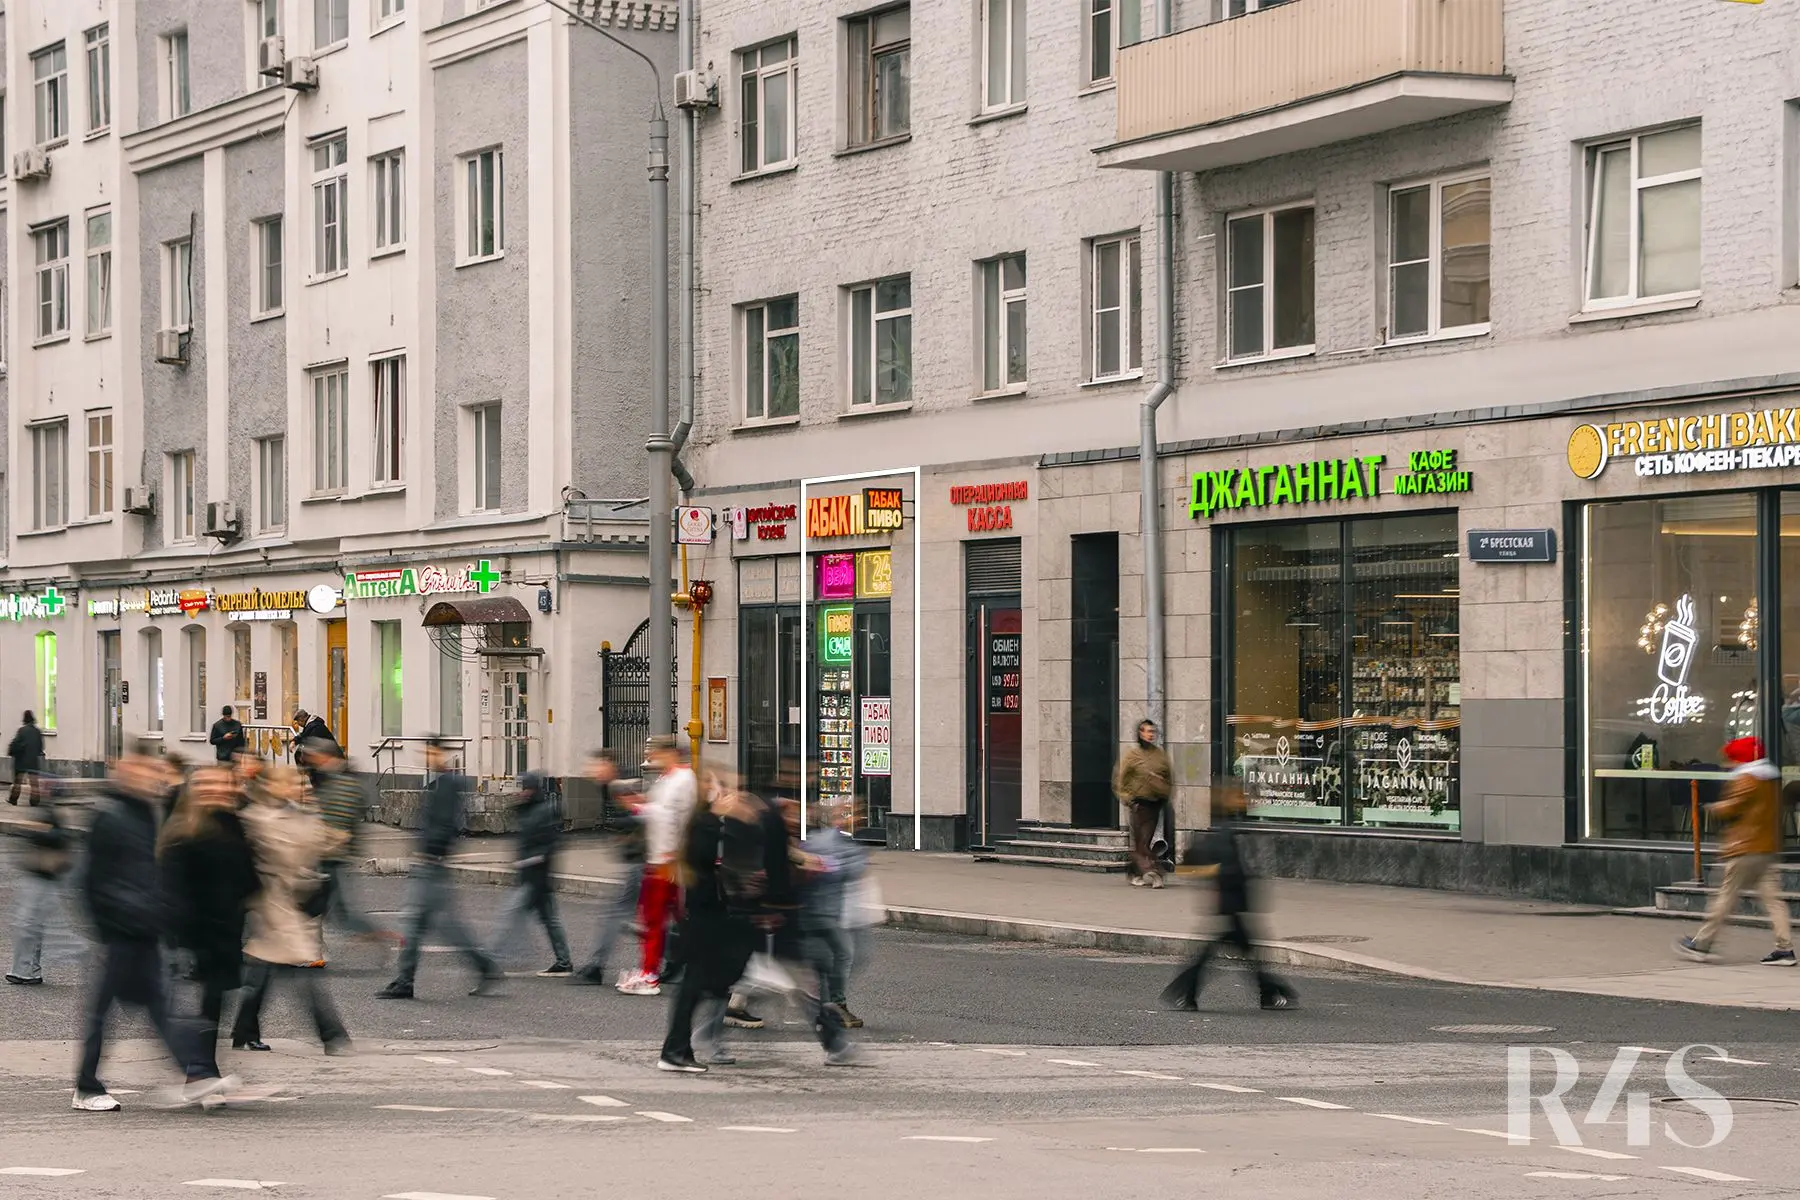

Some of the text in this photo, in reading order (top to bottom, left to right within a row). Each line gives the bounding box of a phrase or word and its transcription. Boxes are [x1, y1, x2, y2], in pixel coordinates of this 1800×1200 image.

[1607, 416, 1722, 458] FRENCH
[1409, 449, 1458, 473] КАФЕ
[1635, 455, 1672, 477] СЕТЬ
[949, 481, 1028, 506] ОПЕРАЦИОННАЯ
[1189, 454, 1384, 519] ДЖАГАННАТ
[1394, 471, 1472, 497] МАГАЗИН
[869, 490, 901, 509] ТАБАК
[868, 509, 902, 529] ПИВО
[967, 505, 1013, 532] КАССА
[1490, 537, 1534, 549] БРЕСТСКАЯ
[216, 588, 306, 612] СЫРНЫЙ СОМЕЛЬЕ
[993, 639, 1019, 653] ОБМЕН
[993, 655, 1019, 667] ВАЛЮТЫ
[992, 675, 1001, 686] USD
[863, 703, 891, 722] ТАБАК
[1651, 683, 1704, 724] Coffee
[864, 726, 890, 745] ПИВО
[864, 751, 889, 769] 24/7
[1249, 771, 1317, 785] ДЖАГАННАТ
[1367, 774, 1444, 791] JAGANNATH
